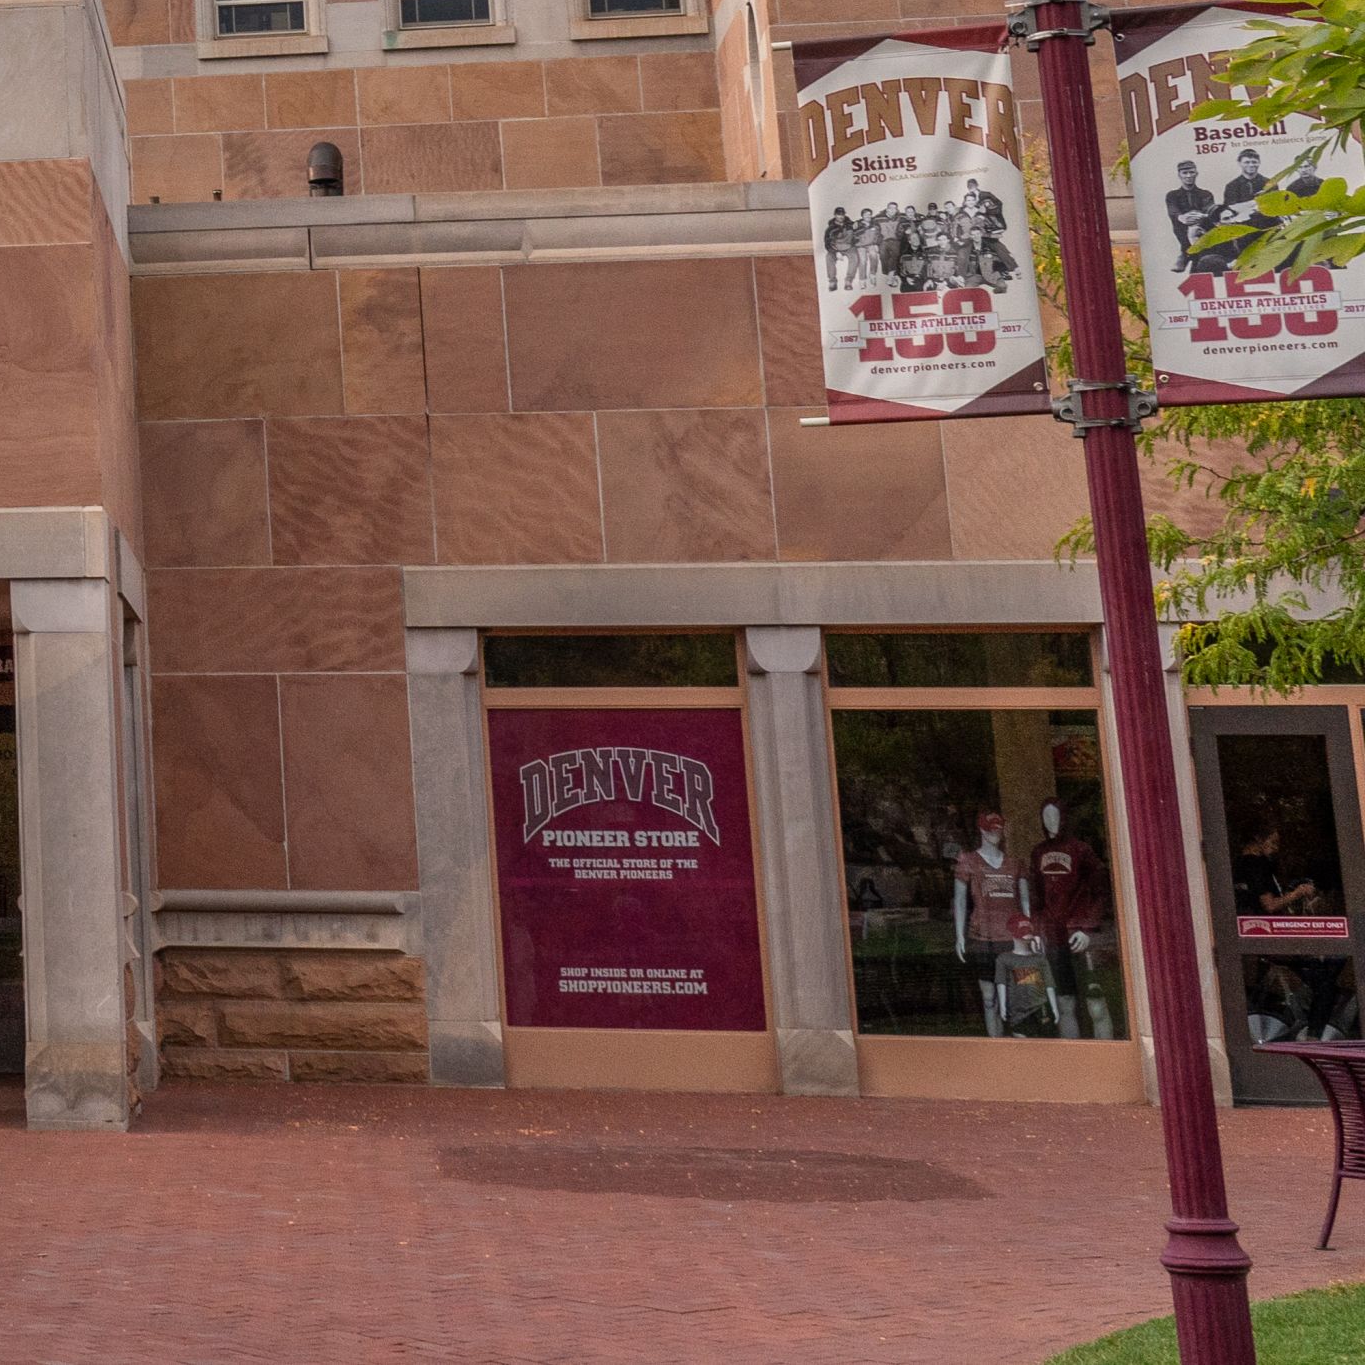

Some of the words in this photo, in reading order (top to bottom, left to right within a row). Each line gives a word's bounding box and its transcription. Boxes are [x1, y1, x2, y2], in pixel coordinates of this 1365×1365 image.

[798, 77, 1022, 185] DENVER
[1196, 142, 1227, 155] 1867
[851, 155, 917, 173] Skiing
[853, 172, 887, 185] 2000
[1177, 265, 1338, 343] 150
[1200, 299, 1252, 311] DENVER
[1256, 294, 1327, 307] ATHLETICS
[1344, 305, 1365, 313] 2017
[848, 287, 996, 362] 150
[869, 320, 918, 332] DENVER
[920, 315, 986, 329] ATHLETICS
[1203, 341, 1338, 355] denverpioneers.com
[870, 359, 996, 375] denverpioneers.com
[520, 747, 720, 847] DENVER
[542, 830, 631, 847] PIONEER
[634, 831, 700, 847] STORE
[548, 858, 570, 868] THE
[573, 858, 620, 868] OFFICIAL
[622, 859, 658, 869] STORE
[660, 859, 674, 869] OF
[676, 859, 698, 869] THE
[574, 870, 618, 879] DENVER
[619, 870, 673, 880] PIONEERS
[560, 967, 588, 977] SHOP
[590, 968, 627, 978] INSIDE
[629, 968, 644, 978] OR
[646, 969, 687, 979] ONLINE
[689, 969, 704, 979] AT
[559, 980, 708, 995] SHOPPIONEERS.COM
